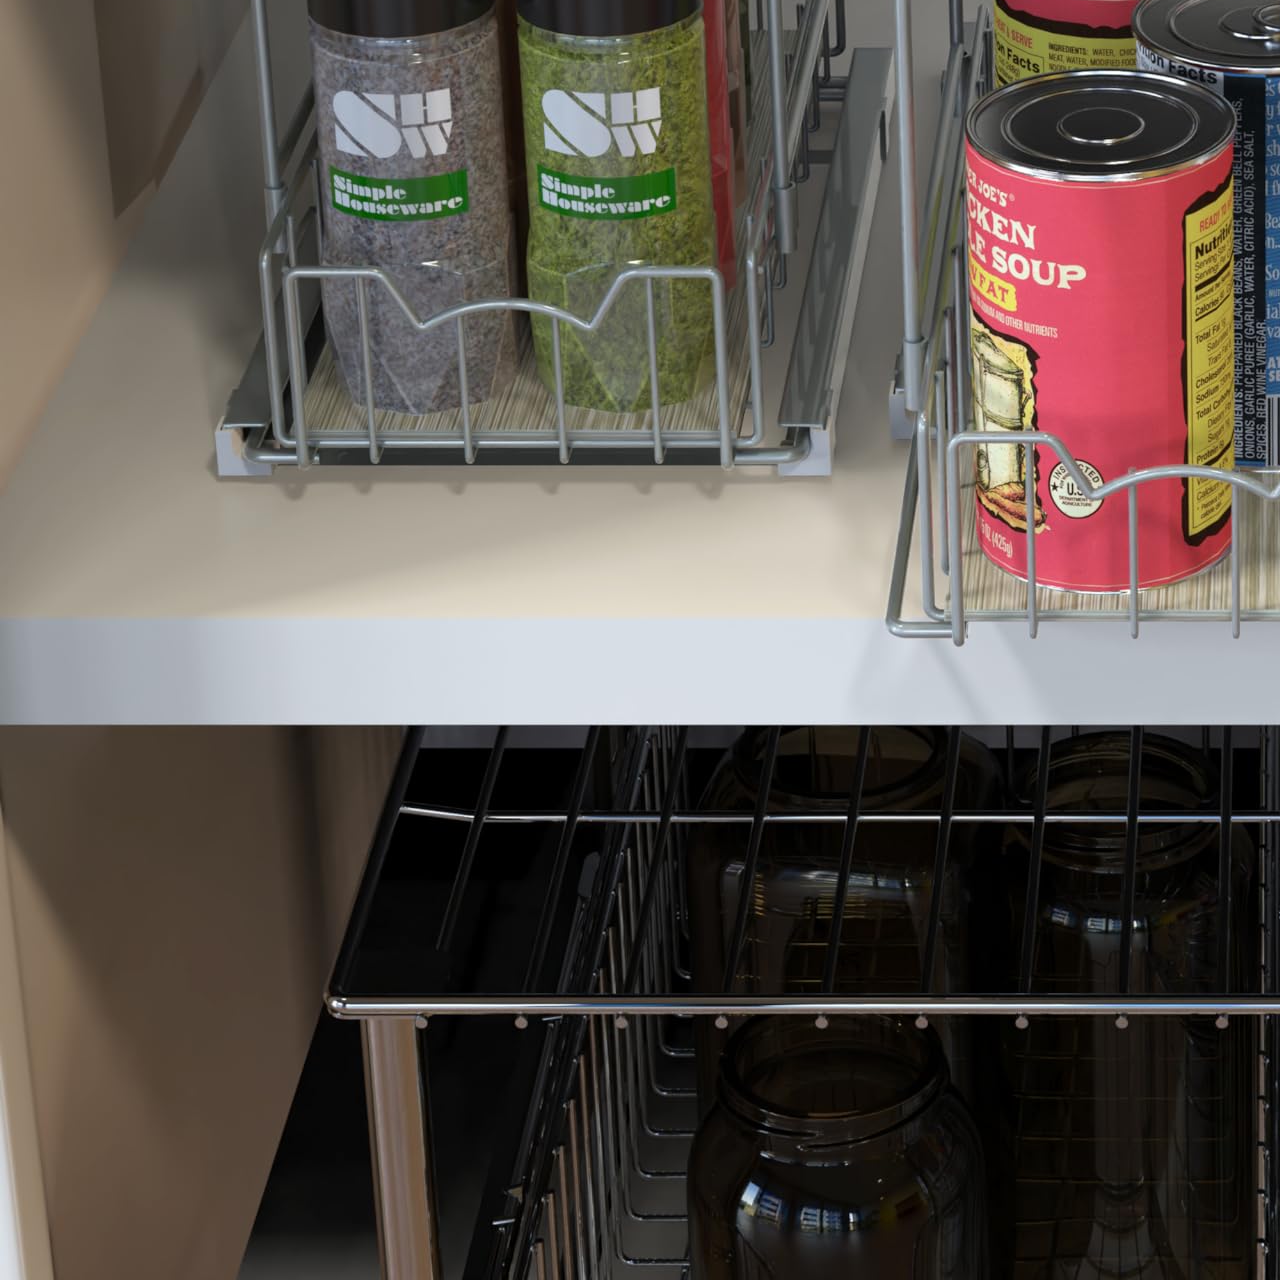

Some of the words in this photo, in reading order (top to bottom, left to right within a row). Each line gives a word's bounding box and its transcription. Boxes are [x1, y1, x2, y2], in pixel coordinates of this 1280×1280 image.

[1011, 28, 1033, 48] SERVE
[1048, 42, 1088, 56] INGREDIENTS:
[1007, 47, 1040, 74] Facts
[1090, 58, 1121, 67] MODIFIED
[1168, 61, 1218, 85] Facts
[1233, 152, 1243, 176] BELL
[1244, 160, 1255, 181] SEA
[333, 172, 408, 201] Simple
[541, 172, 616, 200] Simple
[1233, 179, 1243, 213] GREEN
[333, 189, 464, 216] Houseware
[541, 189, 671, 216] Houseware
[1244, 217, 1255, 251] CITRIC
[991, 246, 1087, 290] SOUP
[979, 274, 1009, 303] FAT
[1005, 315, 1024, 331] OTHER
[1024, 321, 1058, 338] NUTRIENTS
[1234, 297, 1243, 330] BLACK
[1244, 295, 1256, 339] (GARLIC,
[1195, 328, 1211, 345] Total
[1234, 333, 1243, 385] PREPARED
[1244, 342, 1255, 375] PUREE
[1195, 383, 1220, 404] Sodium
[1256, 369, 1266, 395] WINE
[1244, 378, 1255, 414] GARLIC
[1256, 399, 1266, 418] RED
[1195, 403, 1211, 420] Total
[1234, 388, 1243, 458] INGREDIENTS:
